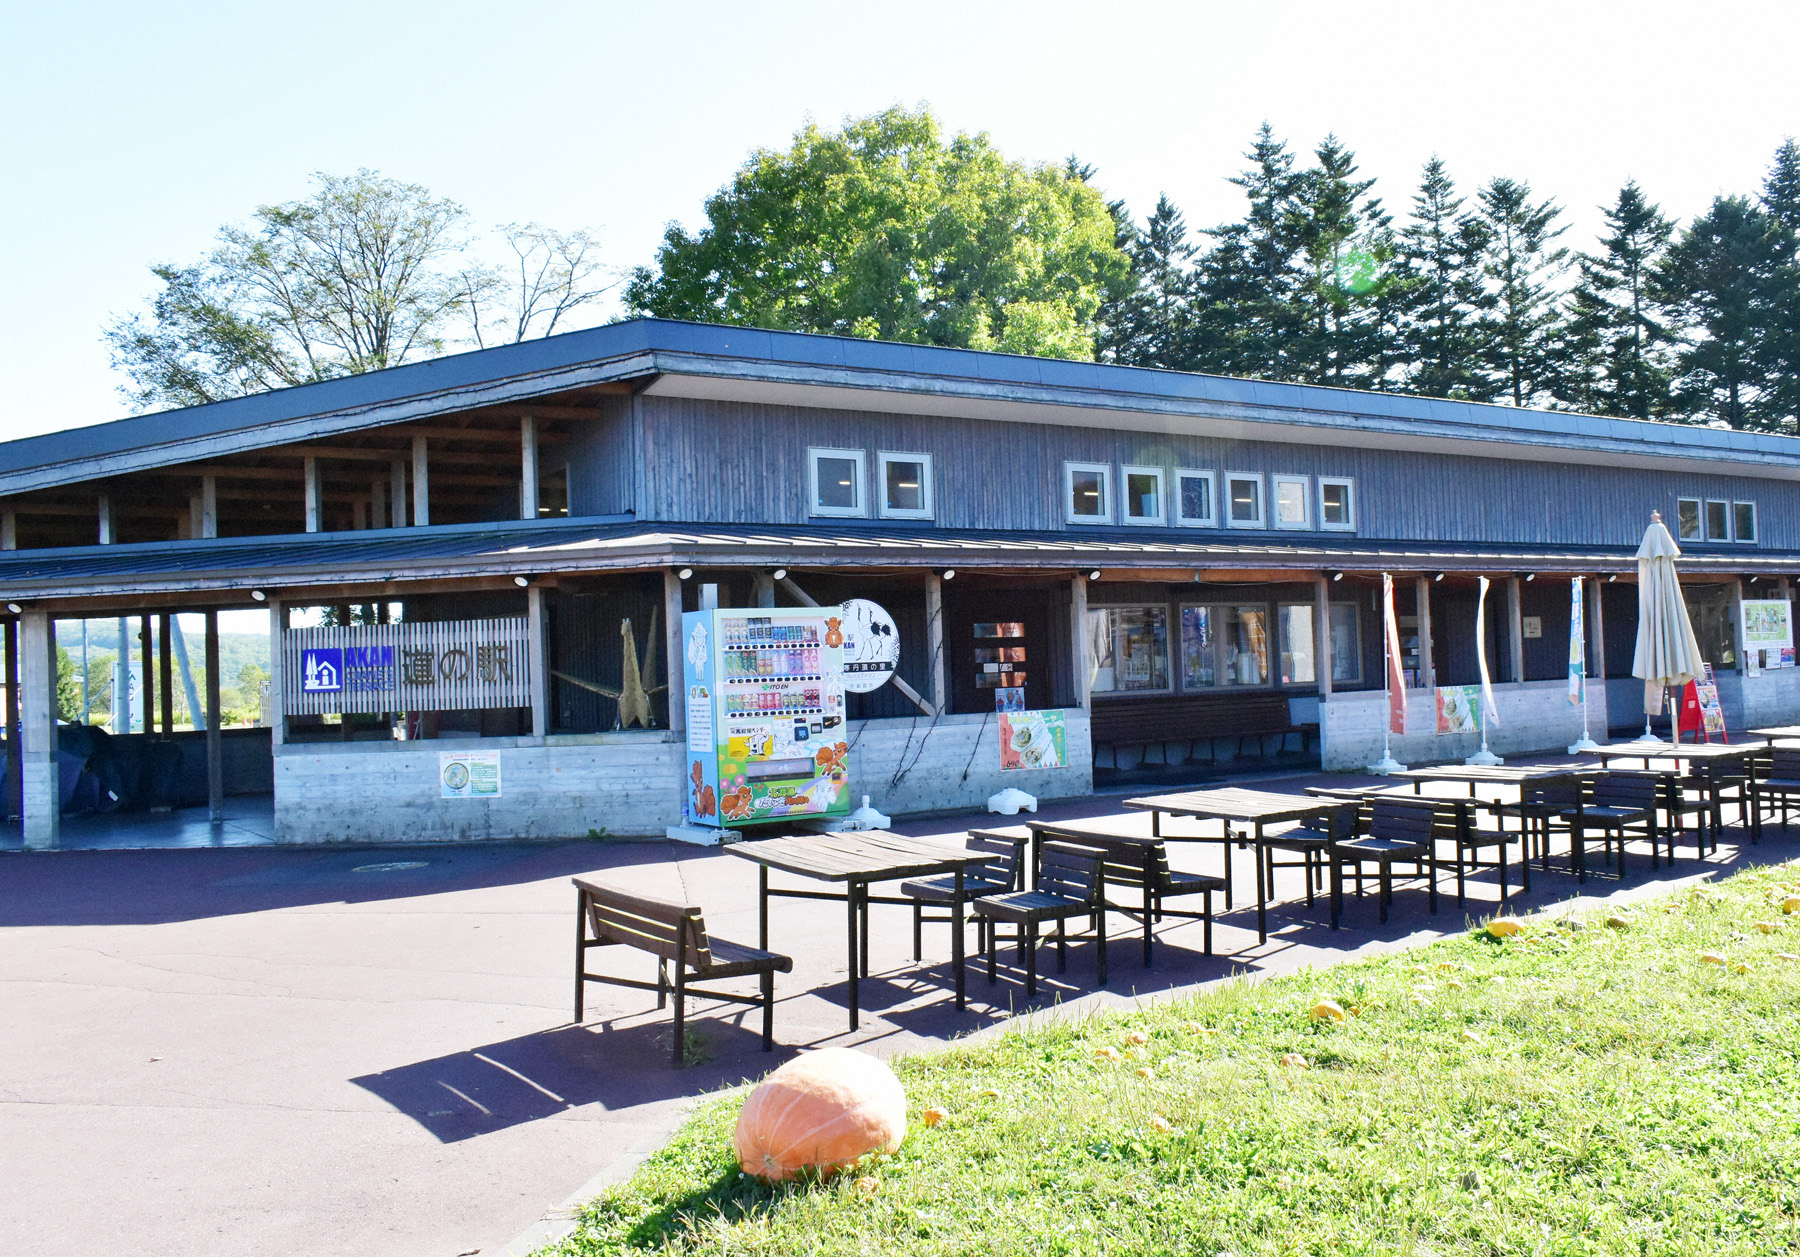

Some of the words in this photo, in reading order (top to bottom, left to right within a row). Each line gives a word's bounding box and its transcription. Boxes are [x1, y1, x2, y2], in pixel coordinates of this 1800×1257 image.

[844, 641, 855, 650] KAN
[346, 646, 393, 668] AKAN
[402, 645, 511, 685] 道の駅
[844, 663, 886, 672] 寒丹頂の里
[346, 680, 395, 692] TERRACE
